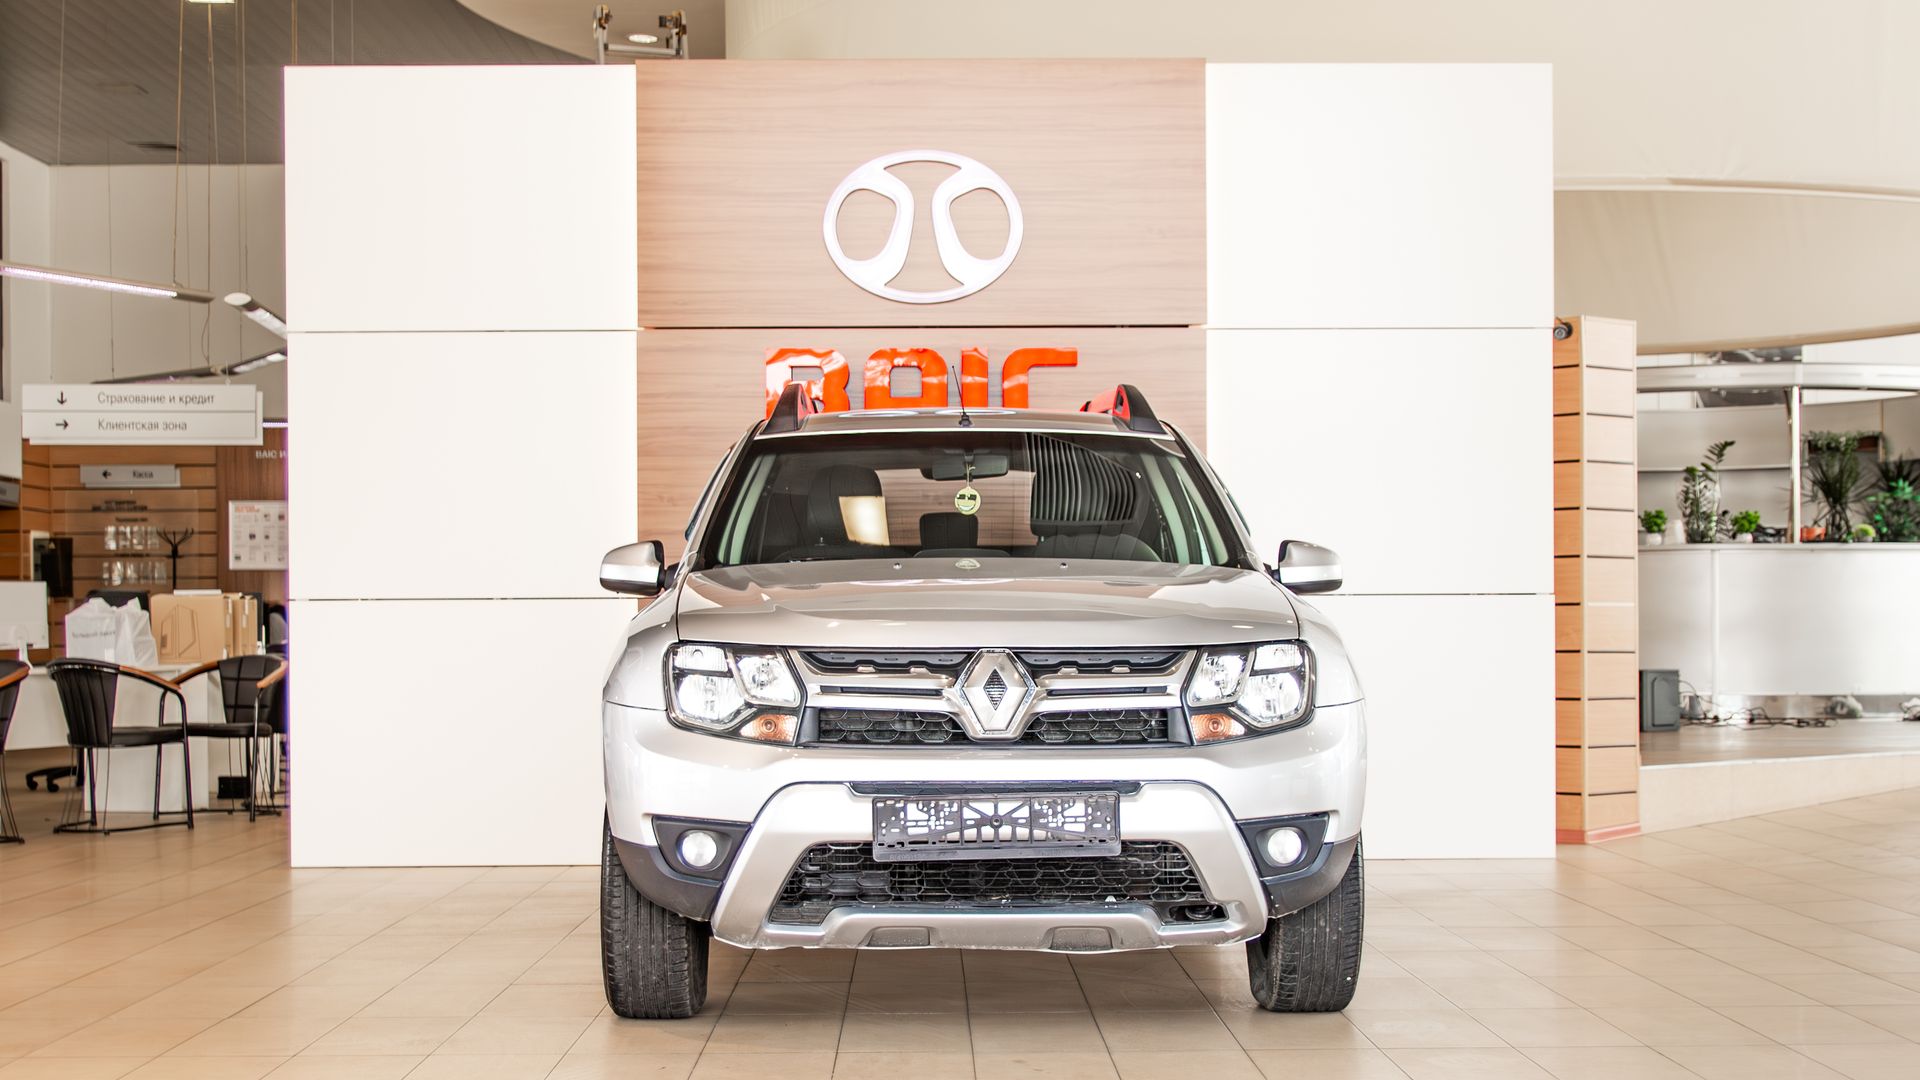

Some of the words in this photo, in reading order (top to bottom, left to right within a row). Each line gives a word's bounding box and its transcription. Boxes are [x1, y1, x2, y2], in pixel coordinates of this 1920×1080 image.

[97, 391, 166, 406] Страхование
[168, 395, 176, 404] и
[178, 394, 215, 406] кредит
[97, 418, 159, 431] Клиентская
[162, 421, 188, 431] зона
[255, 449, 278, 459] BAIC
